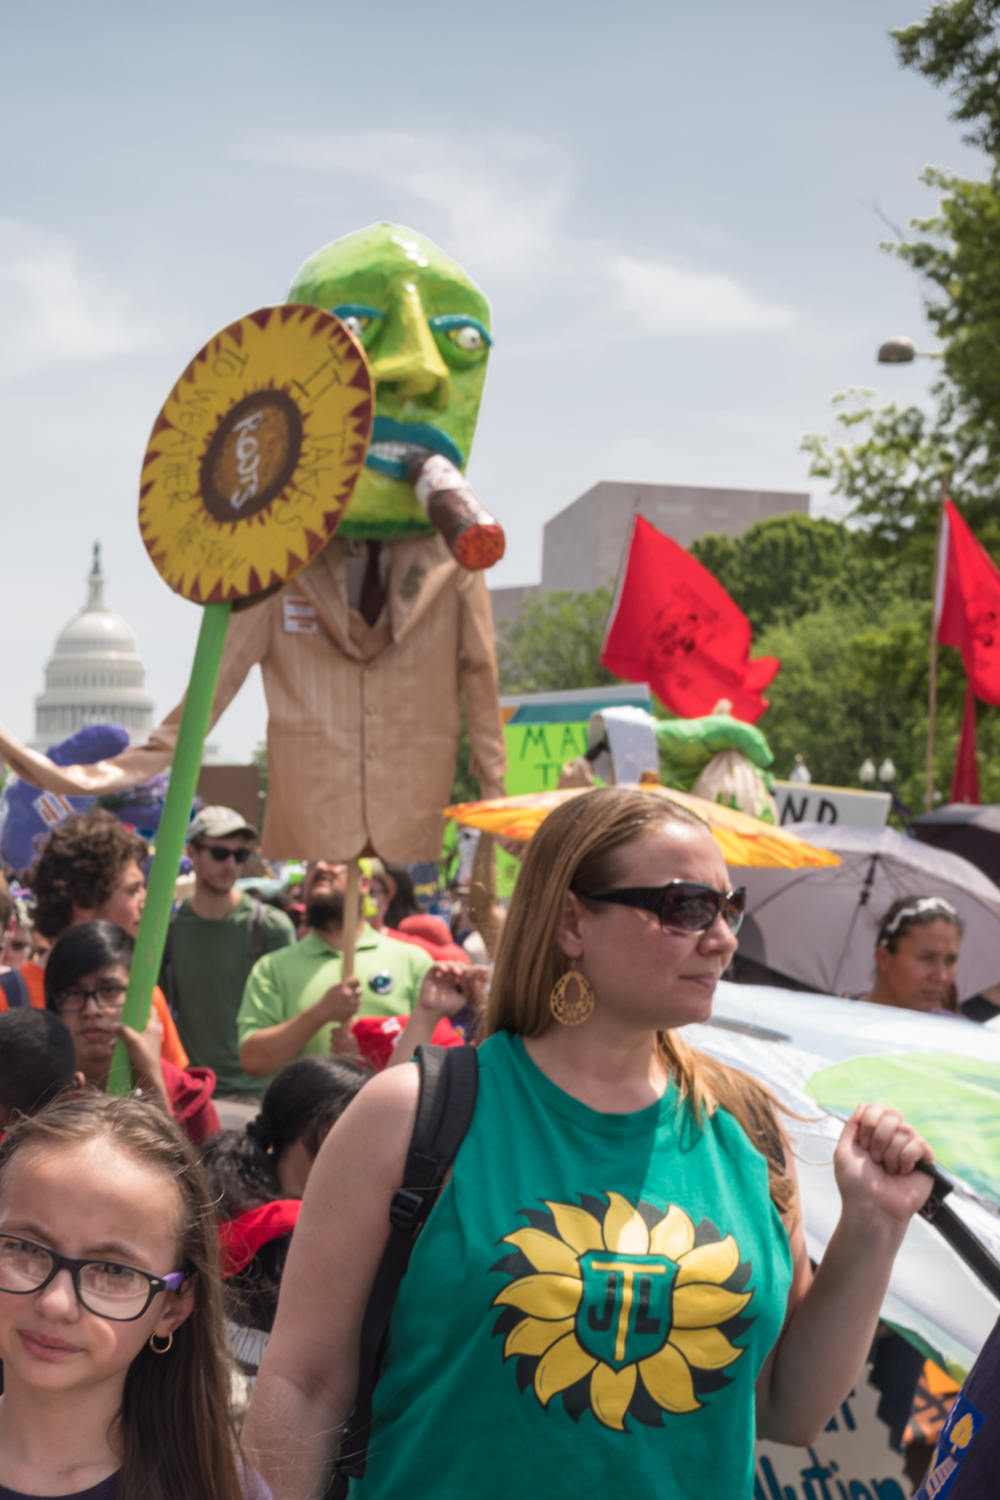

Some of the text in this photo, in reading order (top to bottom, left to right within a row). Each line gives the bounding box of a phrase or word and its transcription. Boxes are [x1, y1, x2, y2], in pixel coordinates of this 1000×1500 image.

[211, 348, 250, 379] TO
[273, 415, 347, 532] TAKES
[519, 726, 589, 761] MA
[770, 790, 838, 826] ND
